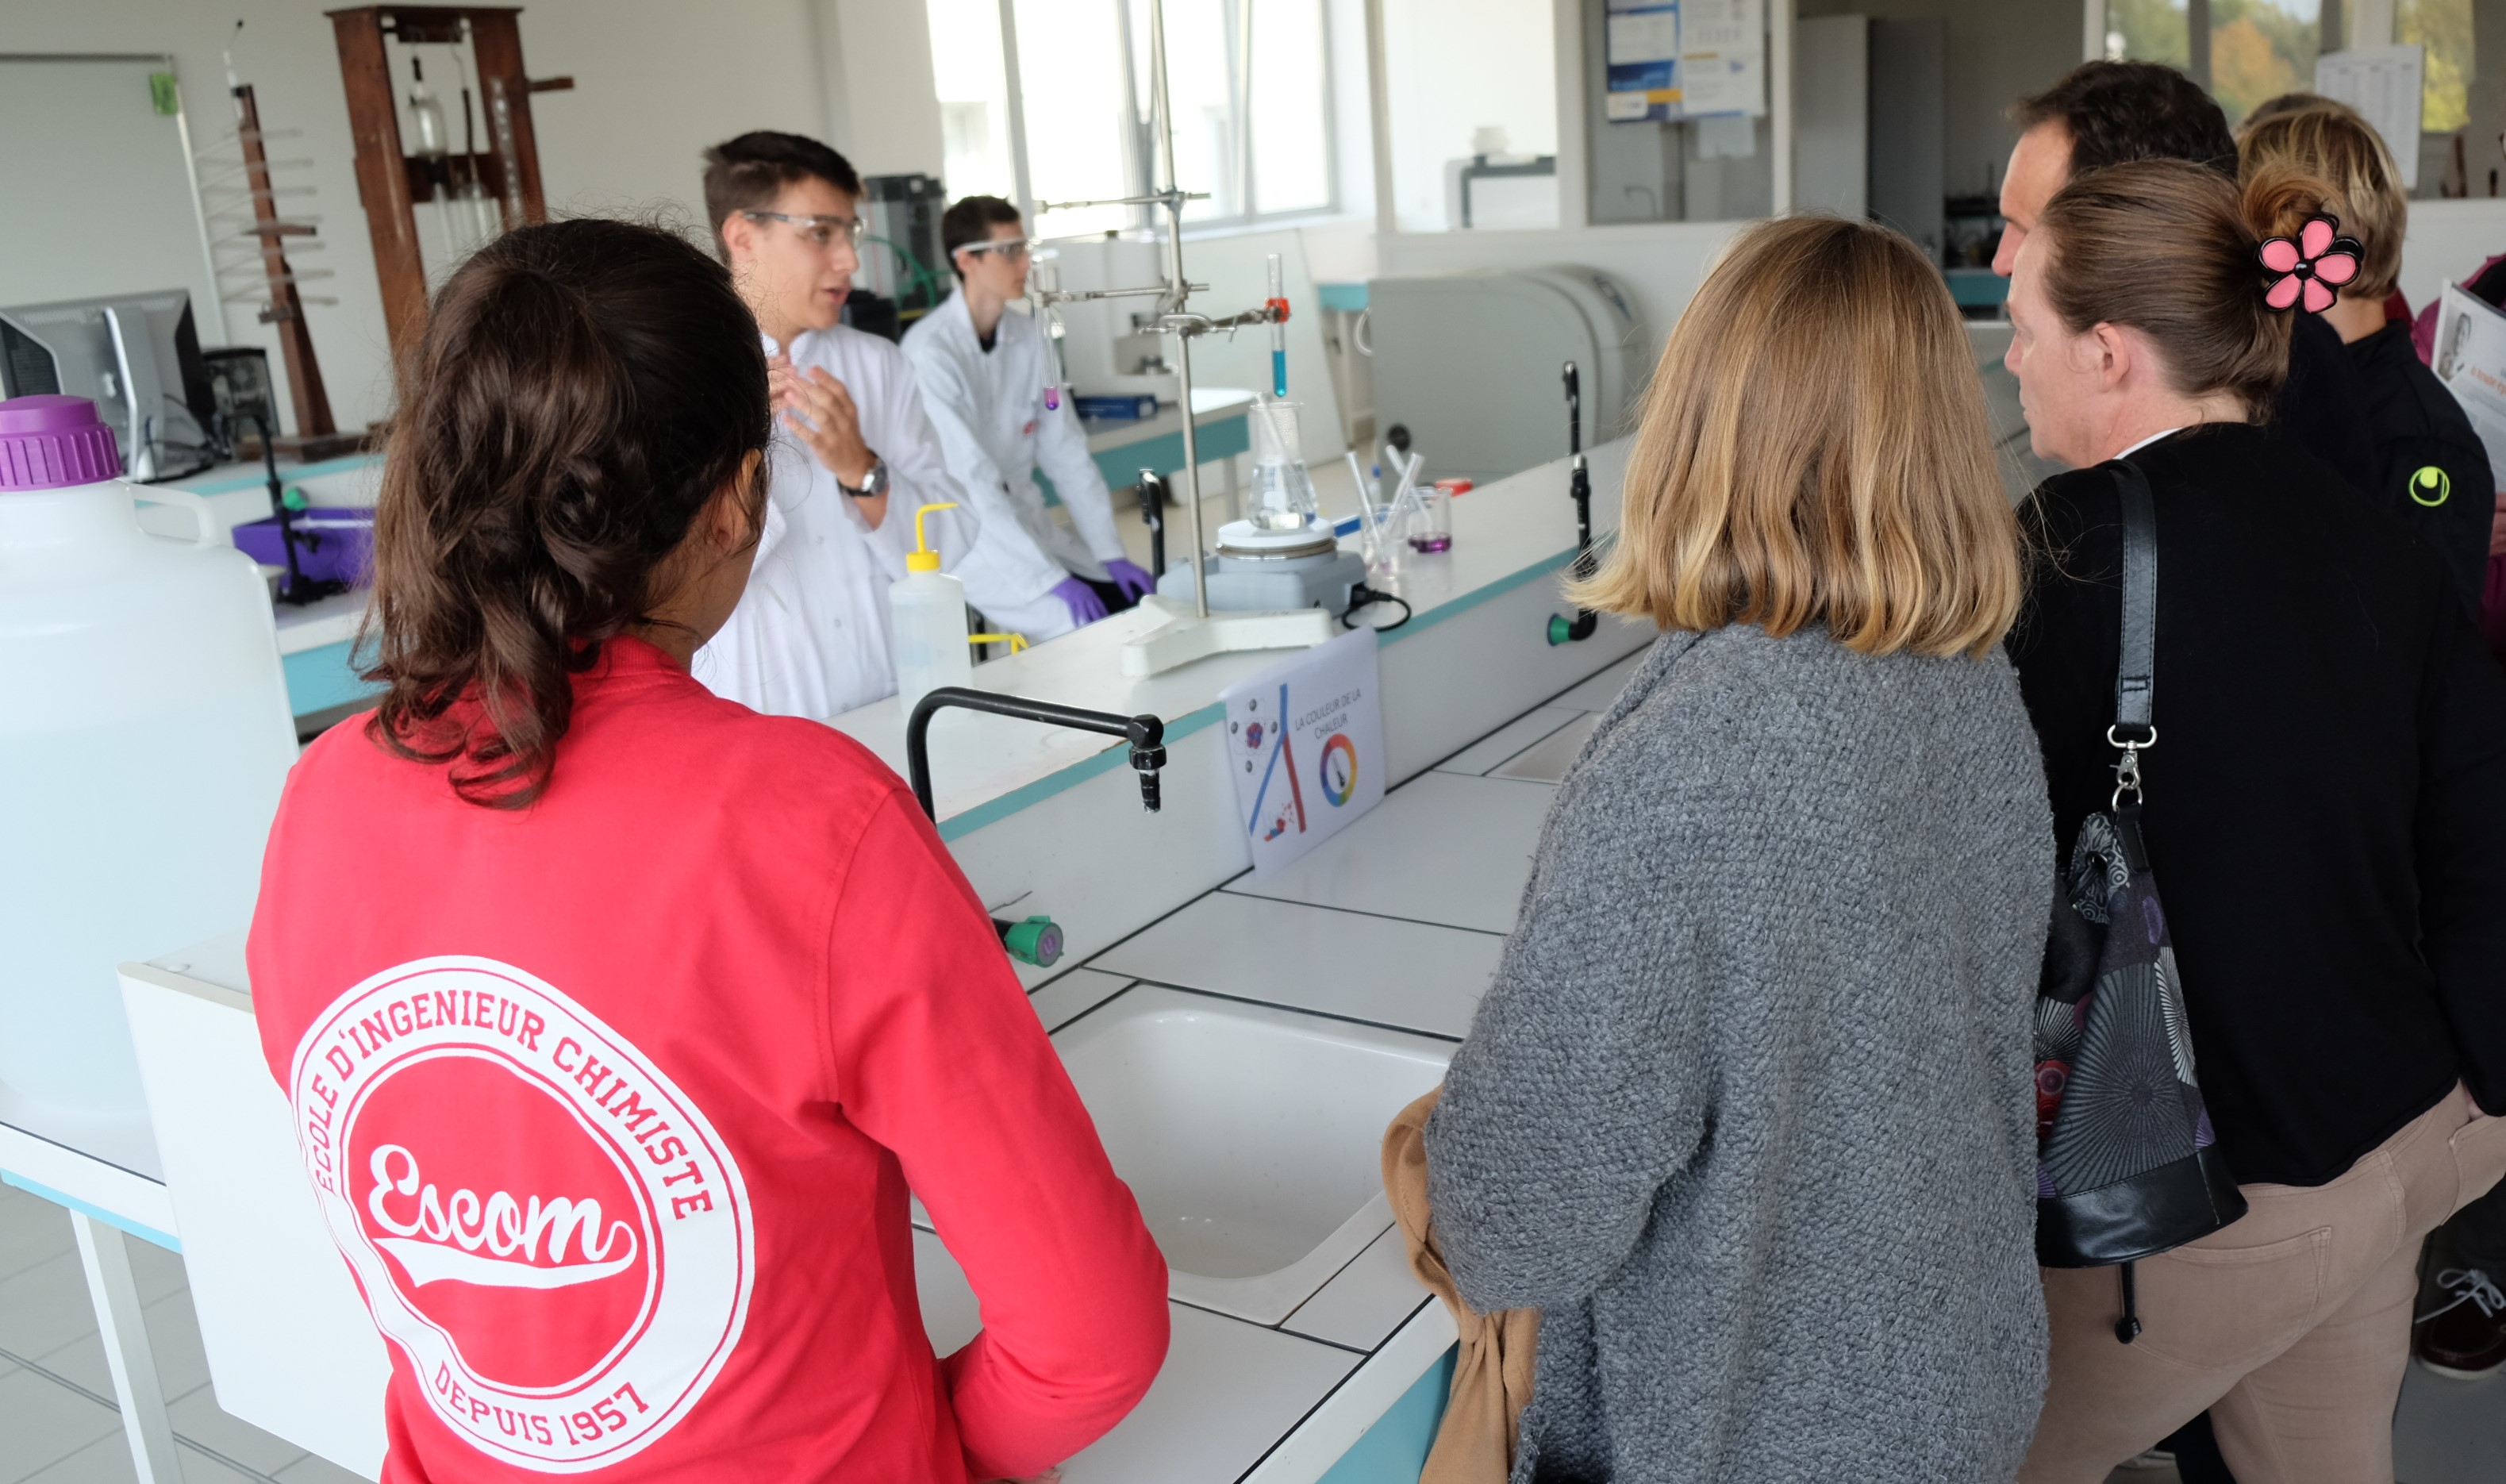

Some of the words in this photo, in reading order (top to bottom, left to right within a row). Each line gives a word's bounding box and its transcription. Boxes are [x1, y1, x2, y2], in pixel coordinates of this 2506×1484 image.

[1295, 717, 1305, 731] LA
[1305, 698, 1340, 725] COULEUR
[1340, 692, 1351, 707] DE
[1351, 688, 1362, 702] LA
[1314, 713, 1348, 740] CHALEUR
[308, 1075, 339, 1197] ECOLE
[325, 990, 545, 1082] D'INGENIEUR
[553, 1036, 714, 1220] CHIMISTE
[368, 1144, 639, 1265] Escom
[434, 1359, 553, 1446] DEPUIS
[559, 1382, 650, 1446] 1957
